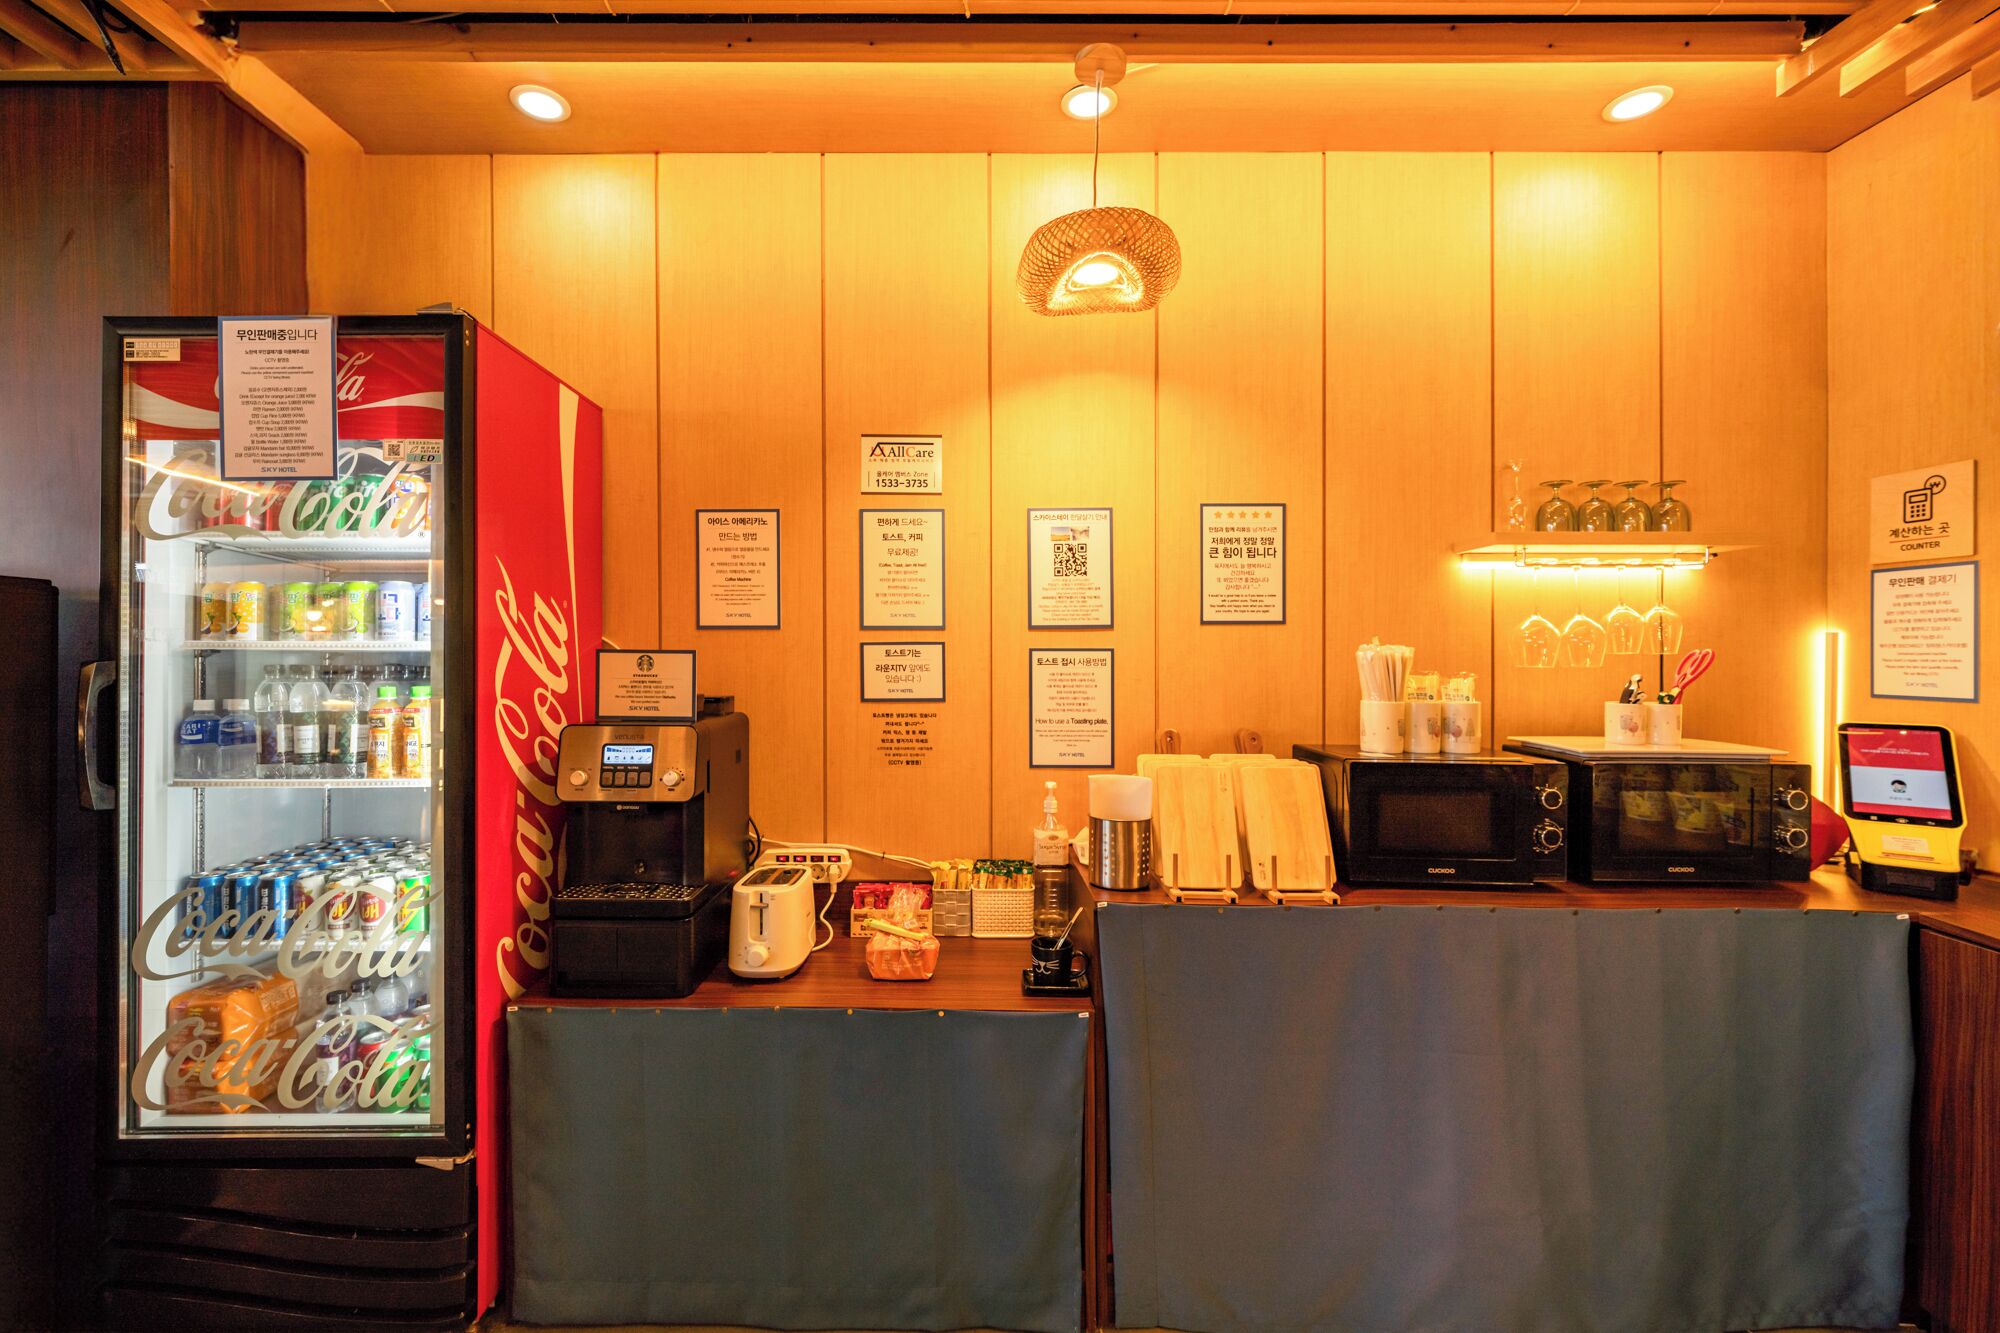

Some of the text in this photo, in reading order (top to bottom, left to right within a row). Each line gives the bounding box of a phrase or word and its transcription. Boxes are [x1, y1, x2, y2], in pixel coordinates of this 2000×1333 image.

[236, 329, 318, 341] 무인판매중입니다
[887, 446, 934, 458] AllCare
[876, 478, 929, 488] 1533-3735
[707, 517, 768, 526] 아이스 아메리카노
[877, 518, 900, 527] 편하게
[1889, 522, 1950, 539] 계산하는 곳
[718, 532, 758, 541] 만드는 방법
[908, 533, 923, 542] 커피
[1211, 536, 1275, 546] 저희에게 정말 정말
[1900, 540, 1941, 552] COUNTER
[887, 548, 918, 557] 무료제공!
[1208, 547, 1277, 559] 큰 힘이 됩니다
[1888, 574, 1957, 588] 무인판매 결제기
[884, 648, 922, 658] 토스트기는
[1036, 657, 1107, 667] 토스트 접시 사용방법
[875, 664, 931, 673] 라운지TV 앞에도
[884, 674, 915, 684] 있습니다
[132, 884, 443, 982] Coca-Cola
[131, 1015, 443, 1111] Coca-Cola
